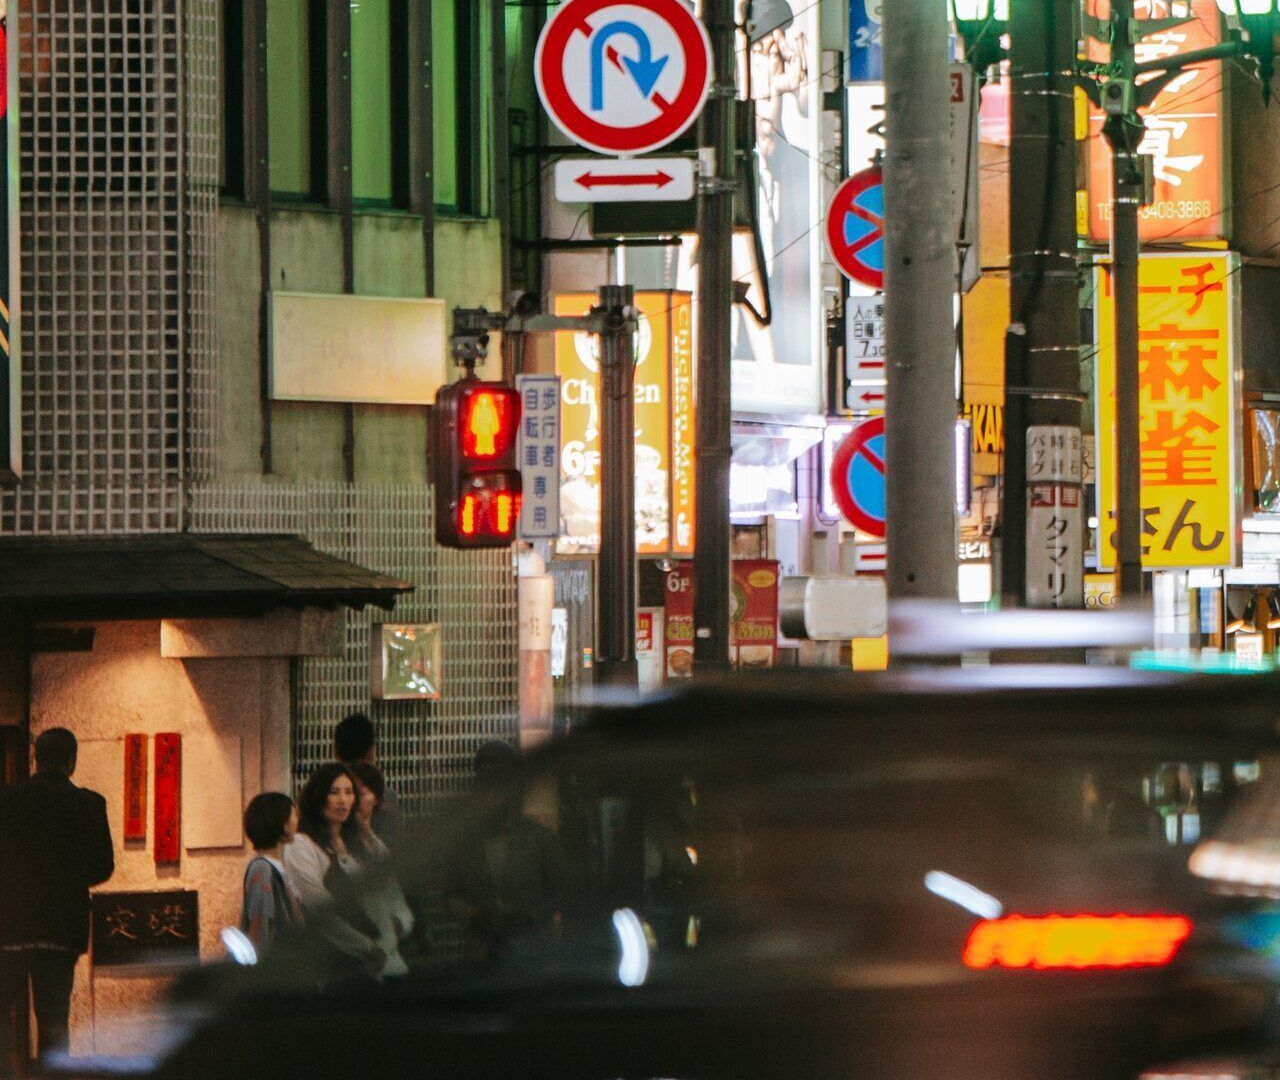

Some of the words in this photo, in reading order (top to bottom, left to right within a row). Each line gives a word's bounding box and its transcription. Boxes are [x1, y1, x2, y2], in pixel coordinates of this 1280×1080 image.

[1097, 202, 1113, 219] TE
[1105, 262, 1223, 316] ーチ
[562, 378, 661, 405] Chen
[1111, 323, 1222, 486] 麻雀
[1045, 515, 1067, 608] タマリ
[666, 573, 690, 593] 6F
